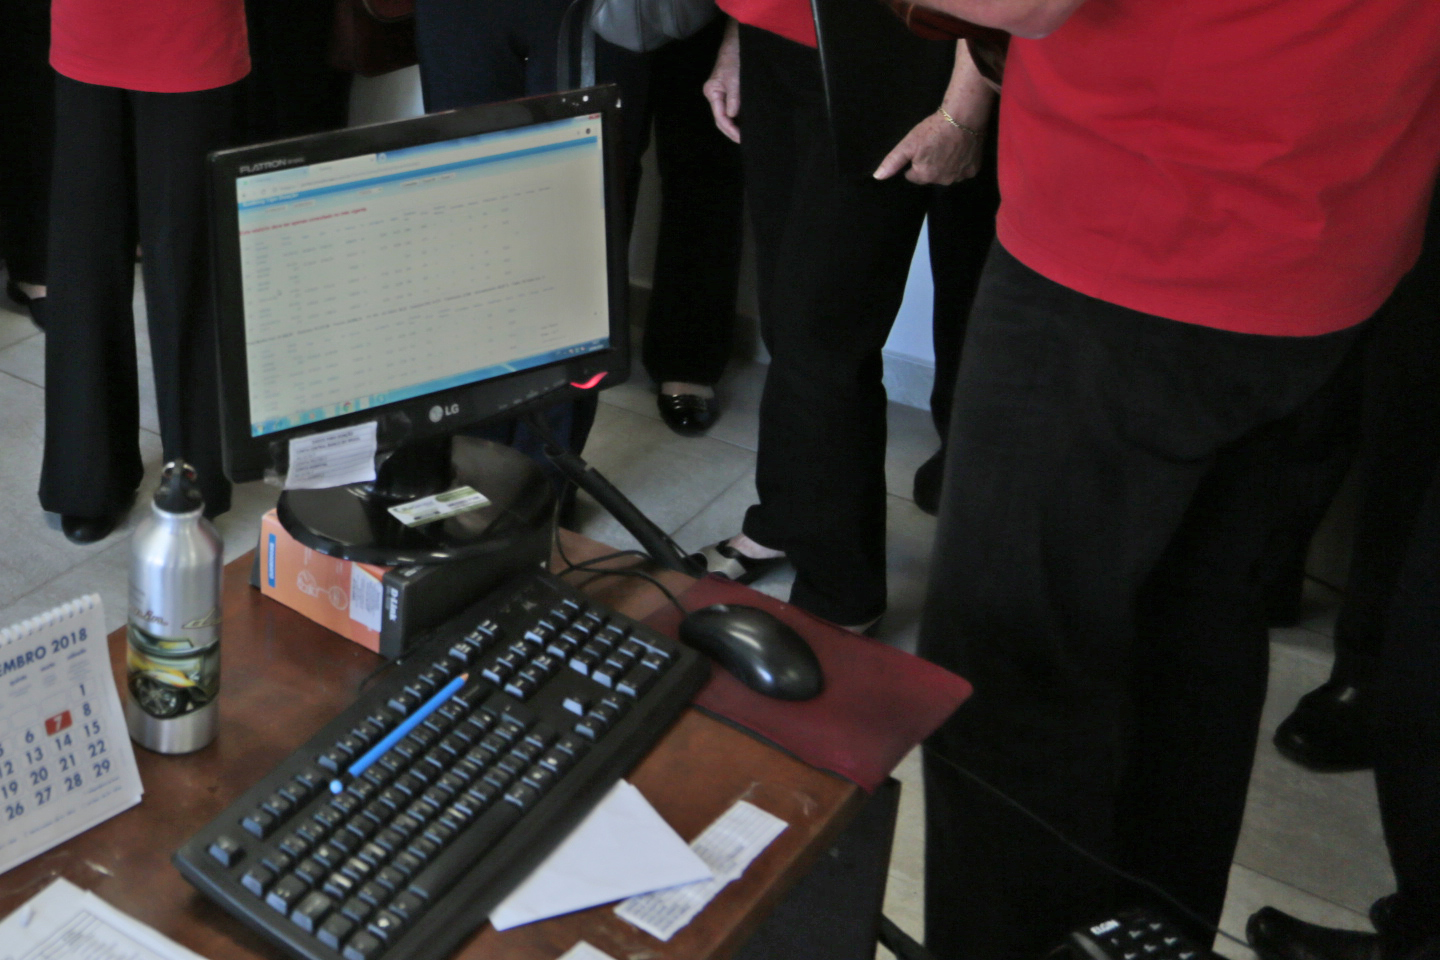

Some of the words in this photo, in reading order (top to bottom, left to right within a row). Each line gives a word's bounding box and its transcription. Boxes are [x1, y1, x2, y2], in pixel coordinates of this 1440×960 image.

[240, 159, 287, 174] FLATRON
[445, 403, 460, 416] LG
[388, 587, 399, 622] D-Link
[51, 628, 88, 654] 2018
[80, 683, 86, 697] 1
[25, 728, 35, 743] 6
[53, 714, 63, 732] 7
[83, 702, 92, 717] 8
[26, 746, 43, 764] 13
[55, 733, 72, 751] 14
[84, 720, 100, 737] 15
[1, 781, 18, 800] 19
[30, 766, 48, 786] 20
[59, 753, 76, 772] 21
[88, 739, 106, 758] 22
[5, 802, 25, 821] 26
[35, 786, 52, 806] 27
[64, 772, 83, 792] 28
[93, 758, 111, 778] 29
